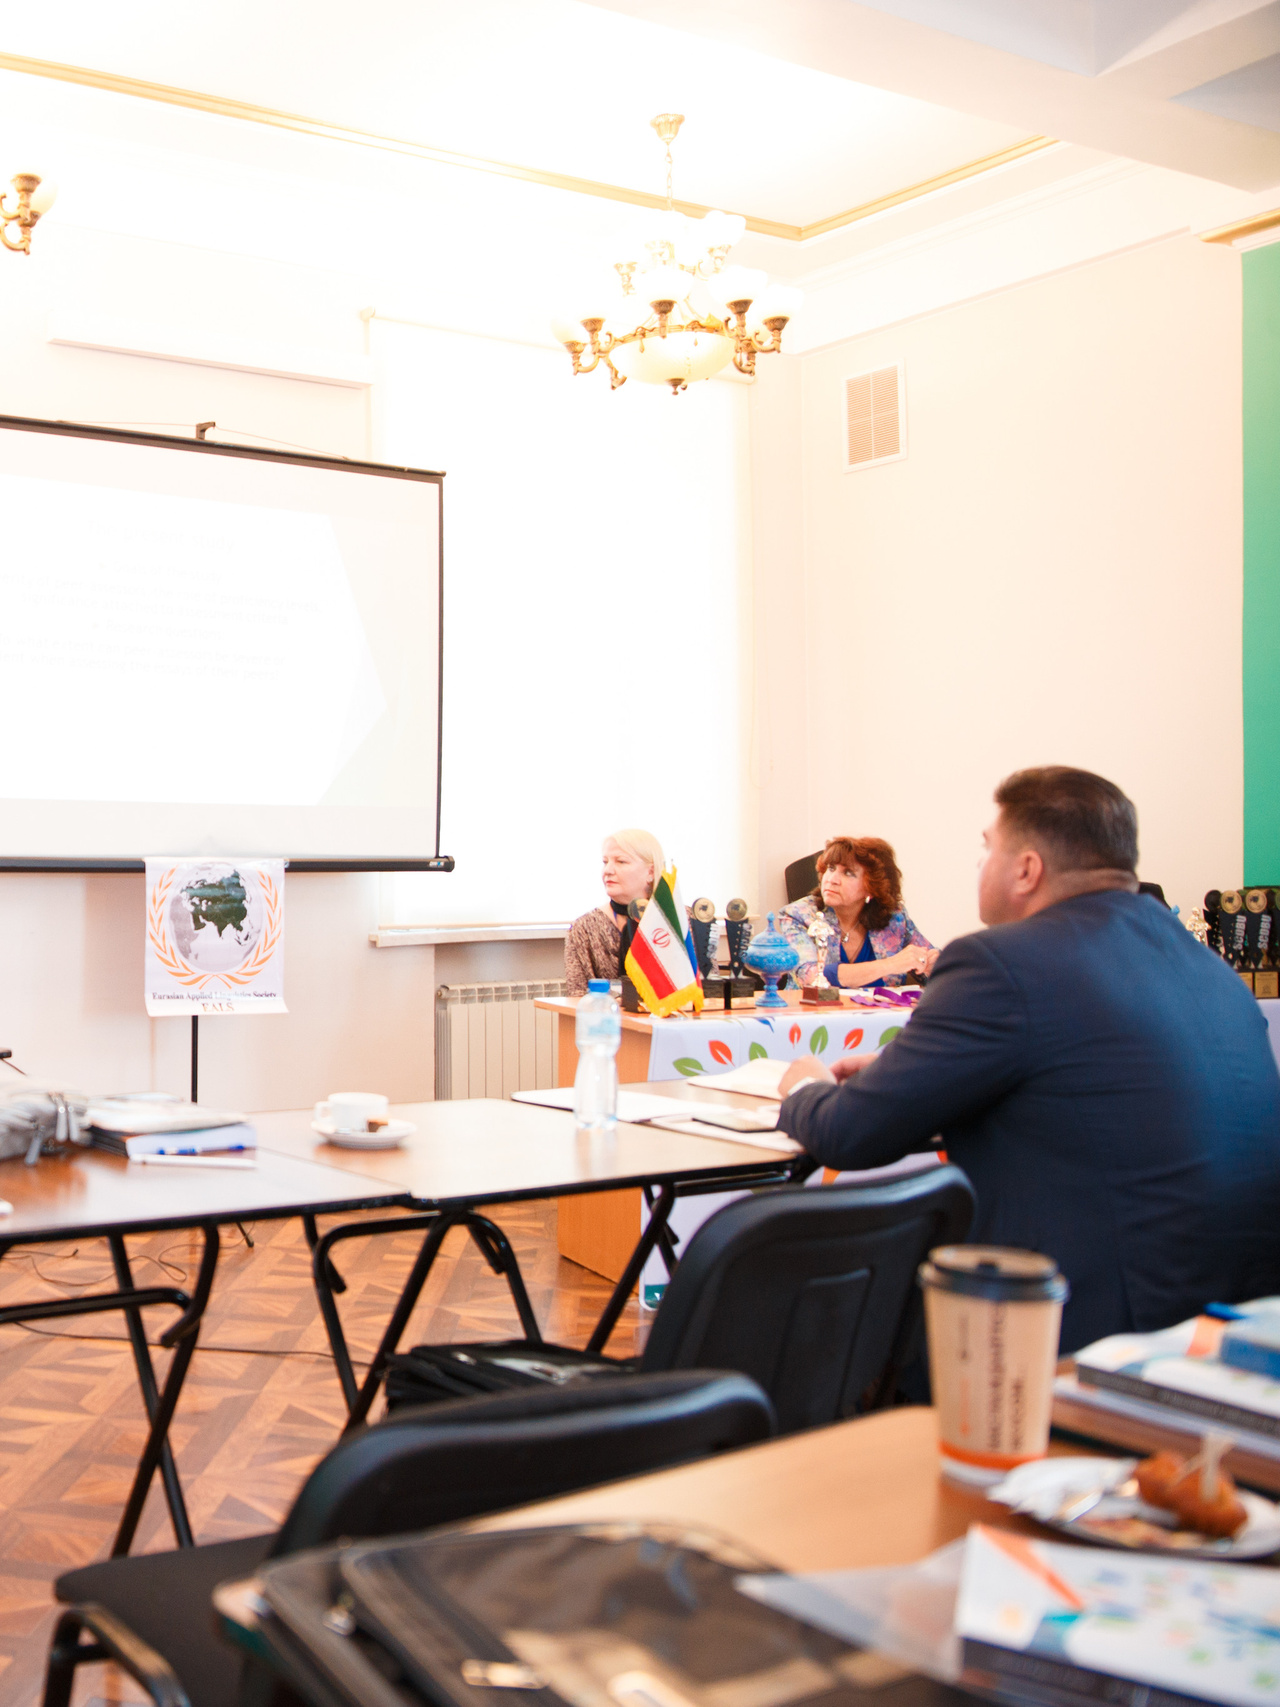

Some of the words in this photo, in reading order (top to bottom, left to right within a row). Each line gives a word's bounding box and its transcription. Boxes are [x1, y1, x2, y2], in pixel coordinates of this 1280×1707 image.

[152, 992, 184, 1000] Eurasian
[186, 991, 213, 1001] Applied
[253, 991, 277, 999] Society
[202, 1003, 235, 1012] EALS
